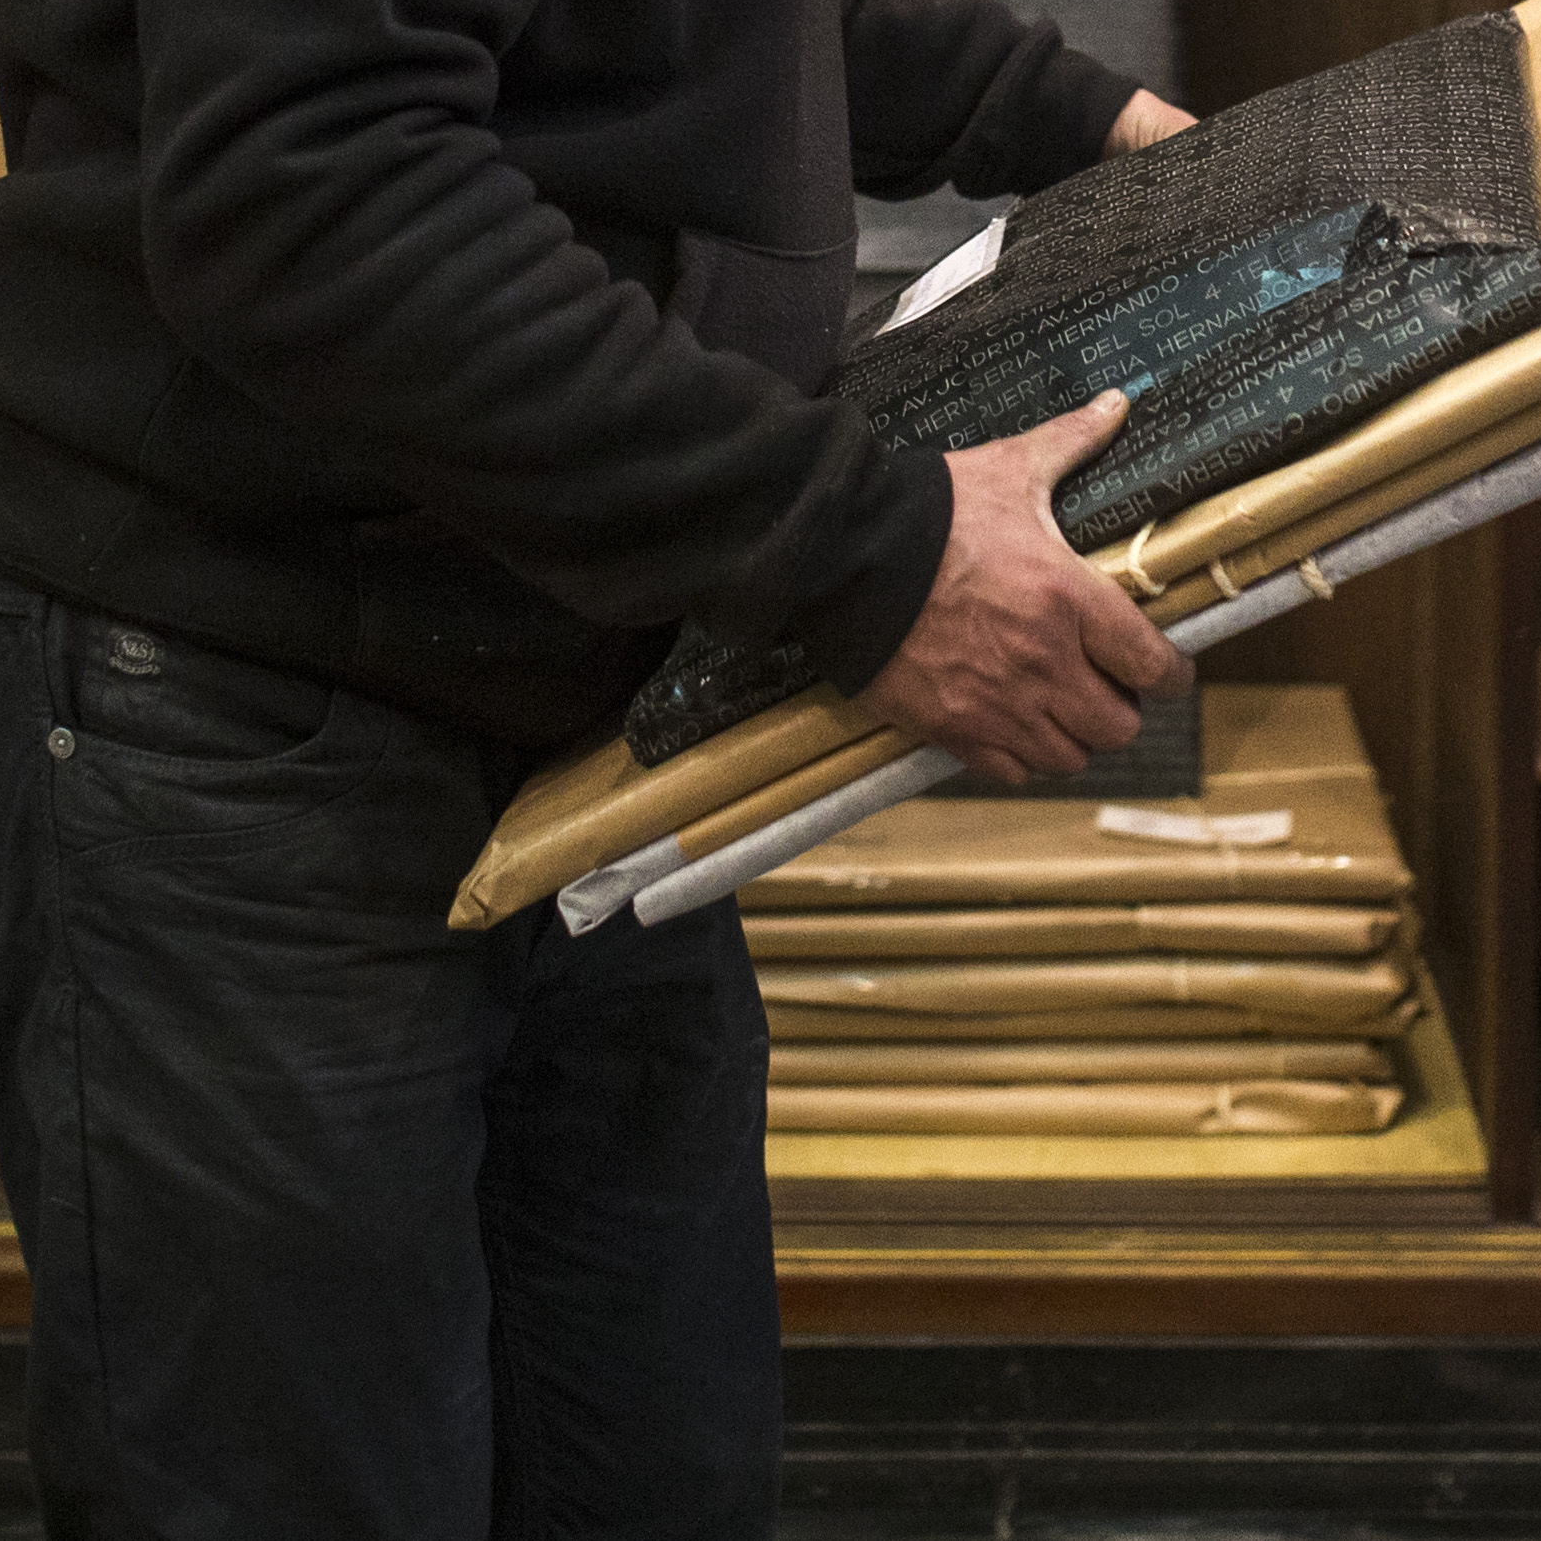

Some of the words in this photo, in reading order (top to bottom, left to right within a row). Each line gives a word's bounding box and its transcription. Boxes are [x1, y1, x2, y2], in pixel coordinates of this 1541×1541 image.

[1047, 274, 1180, 352] HERNANDO
[1073, 277, 1138, 313] JOSE
[1080, 334, 1130, 365] DEL
[1138, 303, 1191, 337] SOL
[1204, 283, 1221, 300] 4
[1157, 279, 1291, 359] HERNANDO
[1372, 316, 1425, 347] DEL
[1207, 328, 1345, 410] HERNANDO
[1276, 386, 1295, 405] 4
[1310, 346, 1364, 385] SOL
[1319, 327, 1466, 416] HERNANDO
[1161, 412, 1305, 496] CAMISERIA
